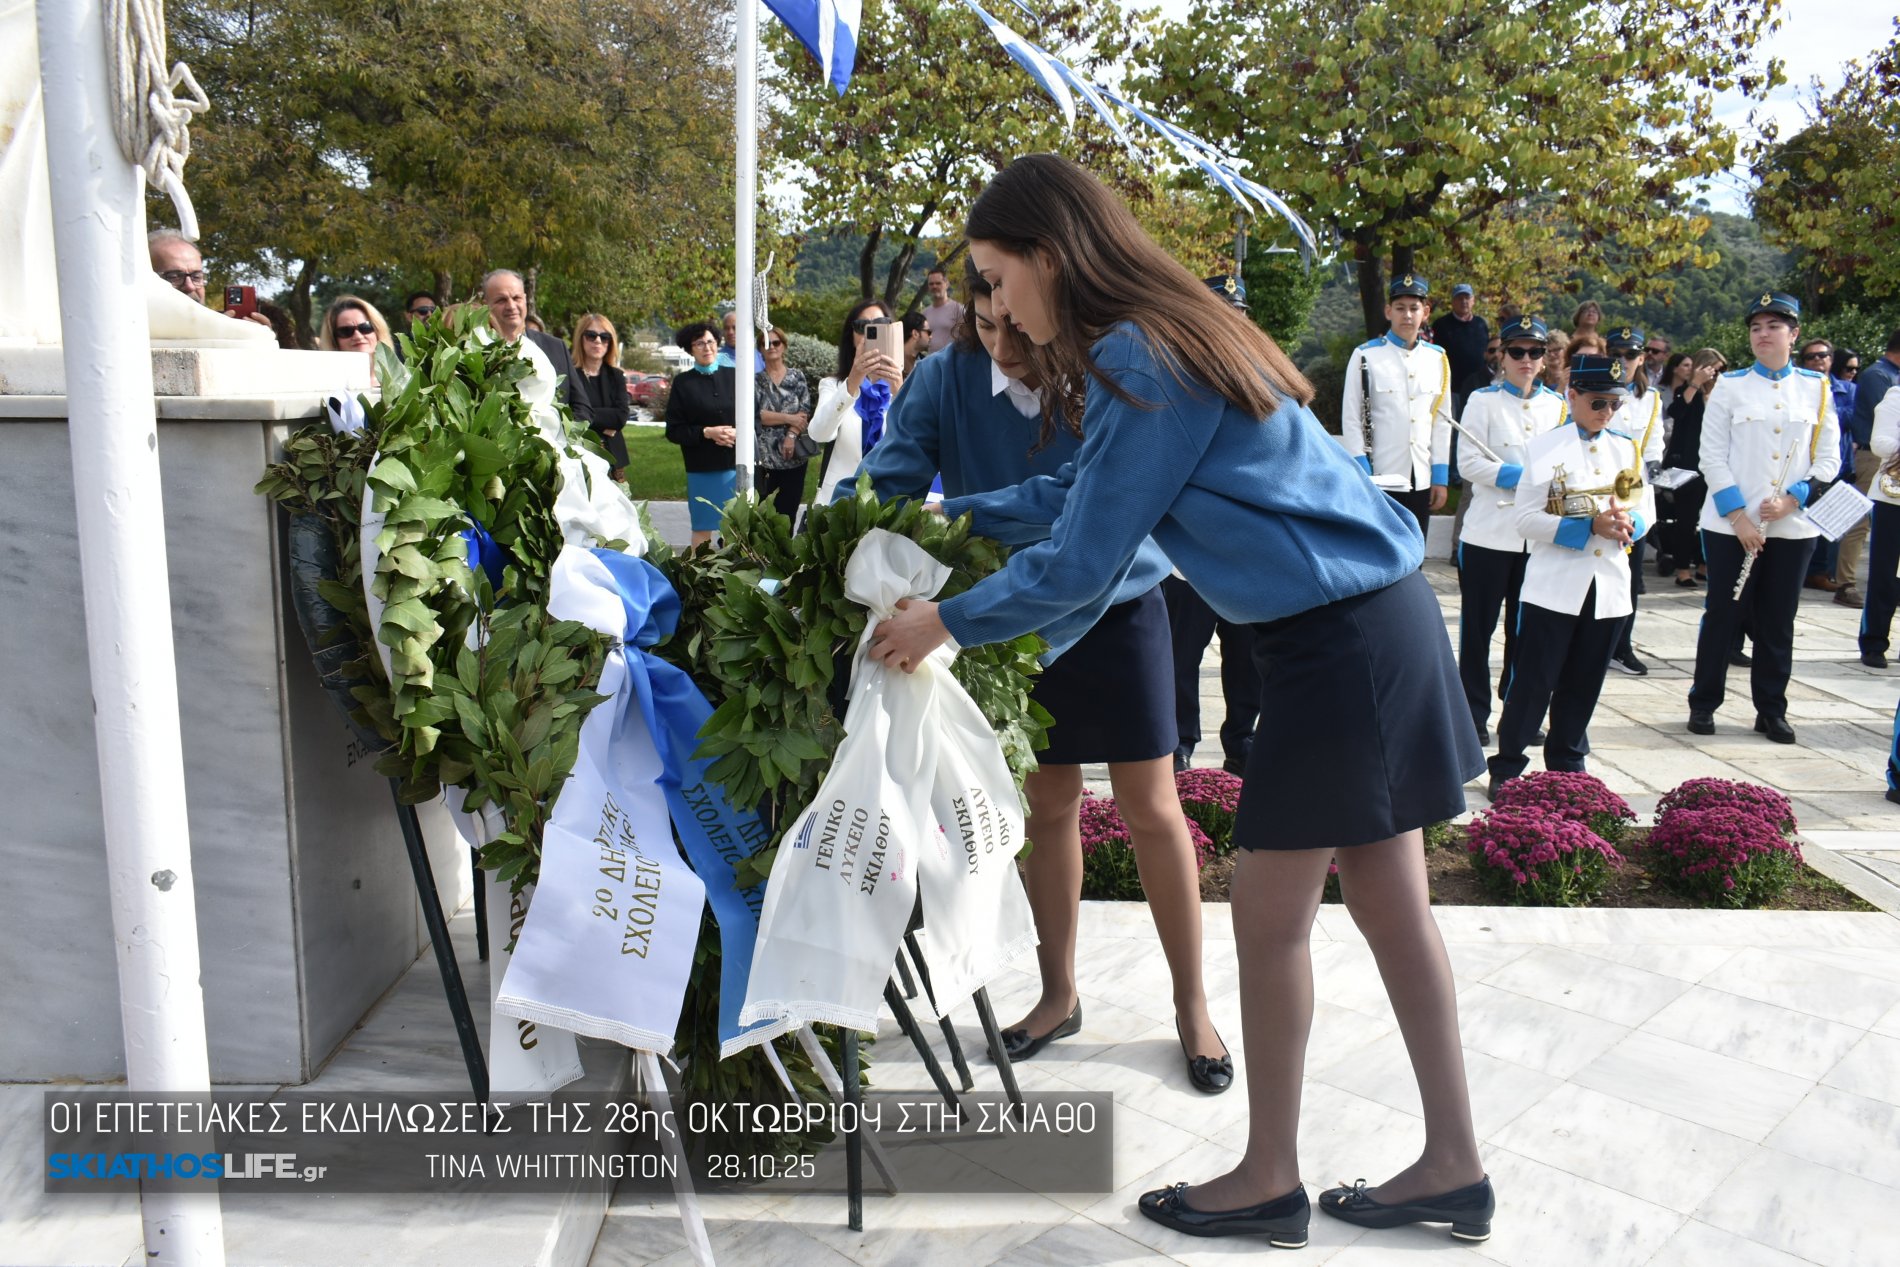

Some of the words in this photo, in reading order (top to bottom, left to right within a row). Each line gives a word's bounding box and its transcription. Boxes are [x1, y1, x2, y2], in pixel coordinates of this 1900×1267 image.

[815, 799, 846, 871] ΓΕΝΙΚΟ
[840, 807, 869, 886] ΛΥΚΕΙΟ
[860, 808, 890, 896] ΣΚΙΑΘΟΥ
[952, 796, 979, 876] ΣΚΙΑΘΟΥ
[970, 787, 994, 855] ΛΥΚΕΙΟ
[621, 855, 661, 959] ΣΧΟΛΕΙΟ
